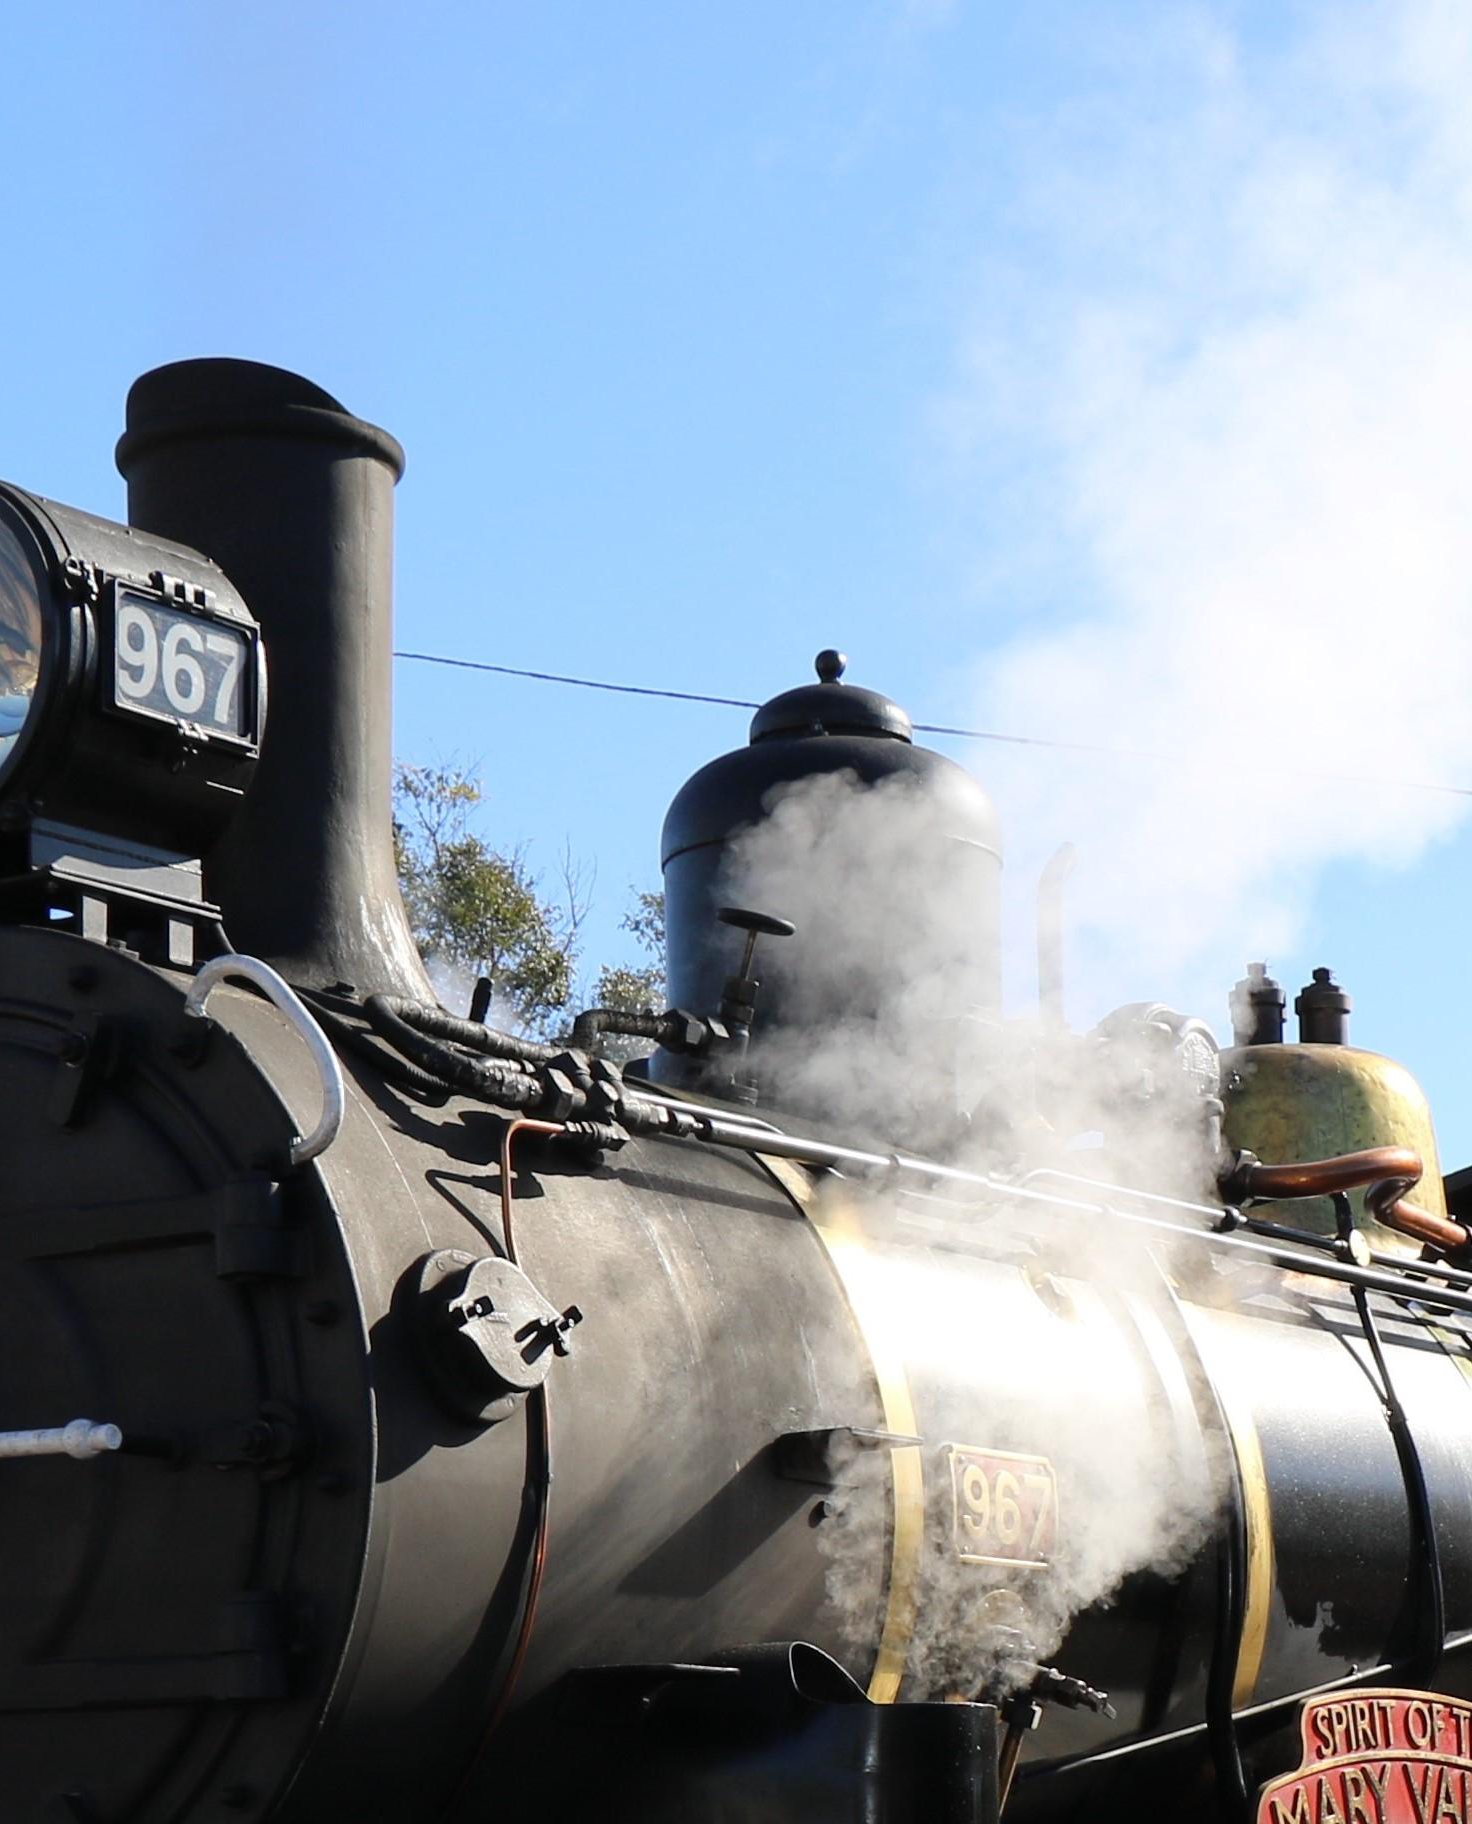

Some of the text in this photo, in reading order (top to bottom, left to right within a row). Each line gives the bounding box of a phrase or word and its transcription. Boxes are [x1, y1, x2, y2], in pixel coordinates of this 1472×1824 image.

[117, 605, 243, 724] 967
[962, 1464, 1052, 1549] 967
[1315, 1700, 1397, 1758] SPIRIT
[1407, 1700, 1447, 1751] OF
